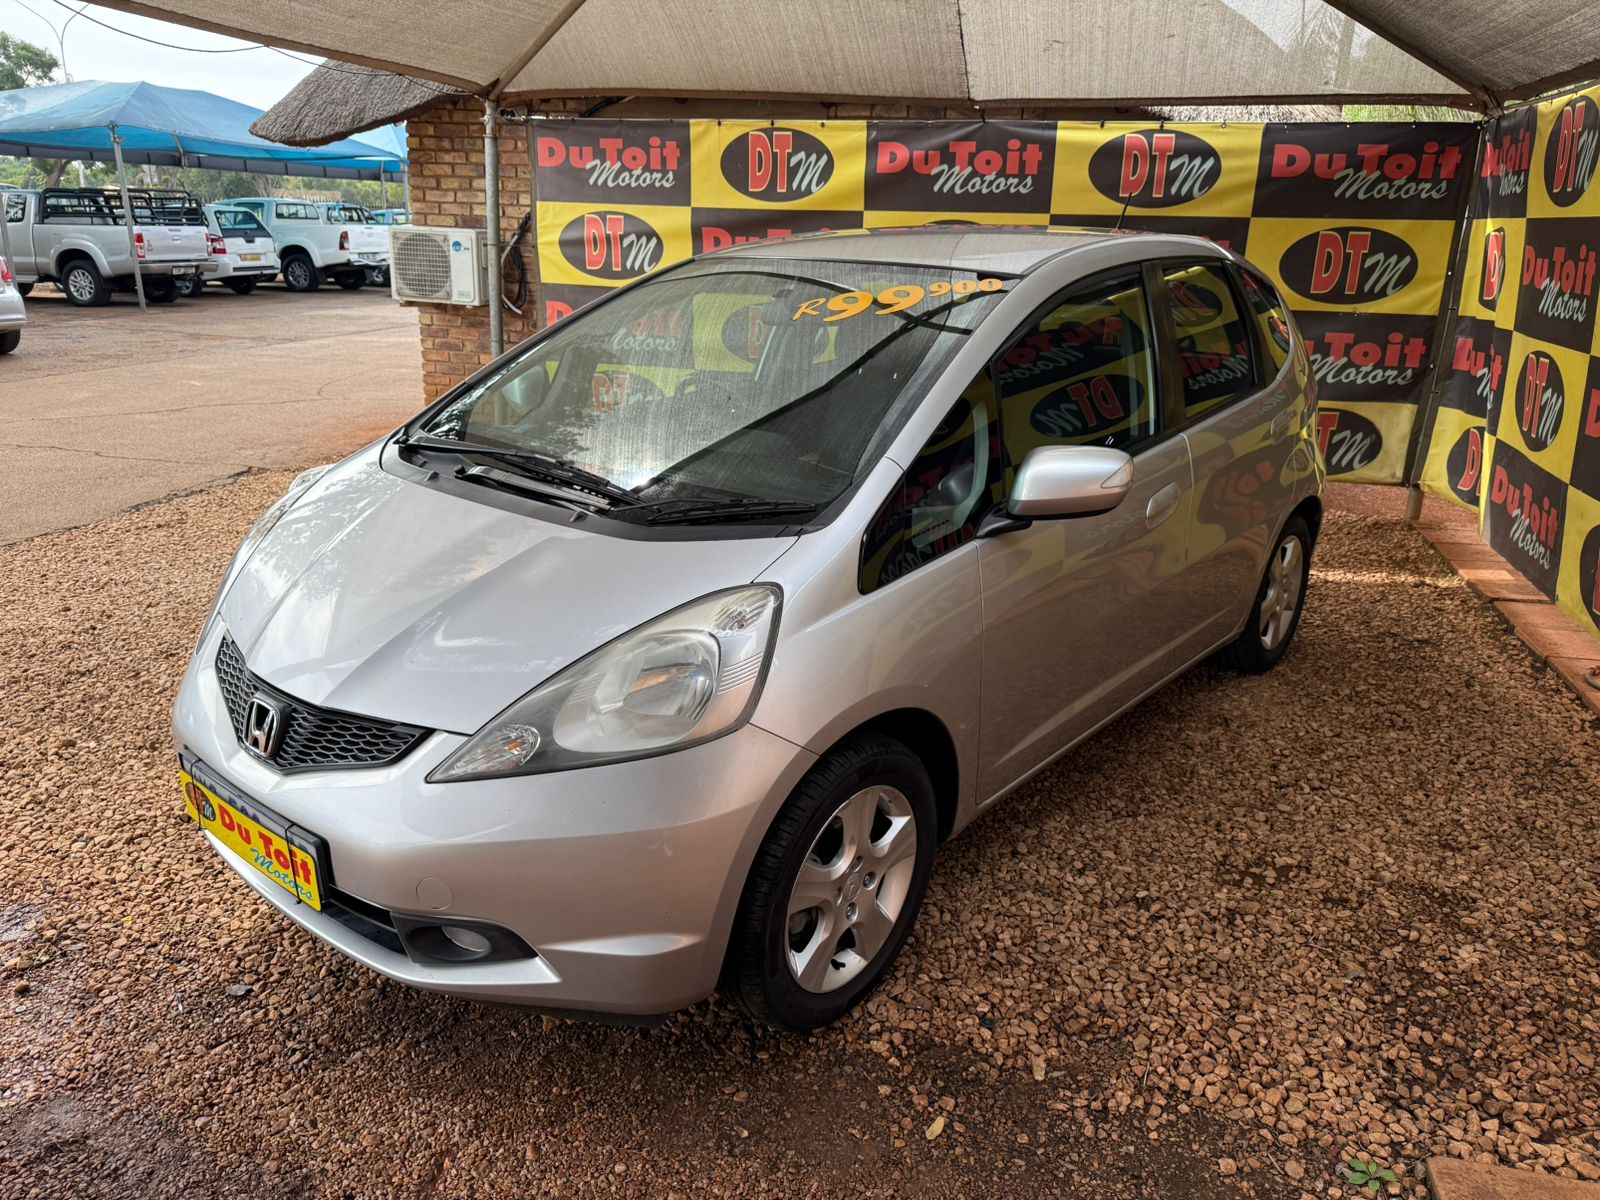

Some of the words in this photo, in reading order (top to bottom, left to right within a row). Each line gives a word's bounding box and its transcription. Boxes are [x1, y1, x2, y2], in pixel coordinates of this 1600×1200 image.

[585, 158, 676, 188] Motors
[748, 131, 828, 193] DTM
[930, 163, 1034, 194] Motors
[1119, 133, 1215, 198] DTM
[1332, 168, 1449, 200] Motors
[584, 213, 658, 273] DTM
[1310, 230, 1412, 296] DTM
[1538, 277, 1588, 323] Motors
[1310, 353, 1414, 386] Motors
[1522, 353, 1563, 446] DTM
[1509, 507, 1551, 570] Motors
[217, 803, 252, 846] Du
[258, 831, 312, 886] Toit
[250, 848, 314, 901] Motors
